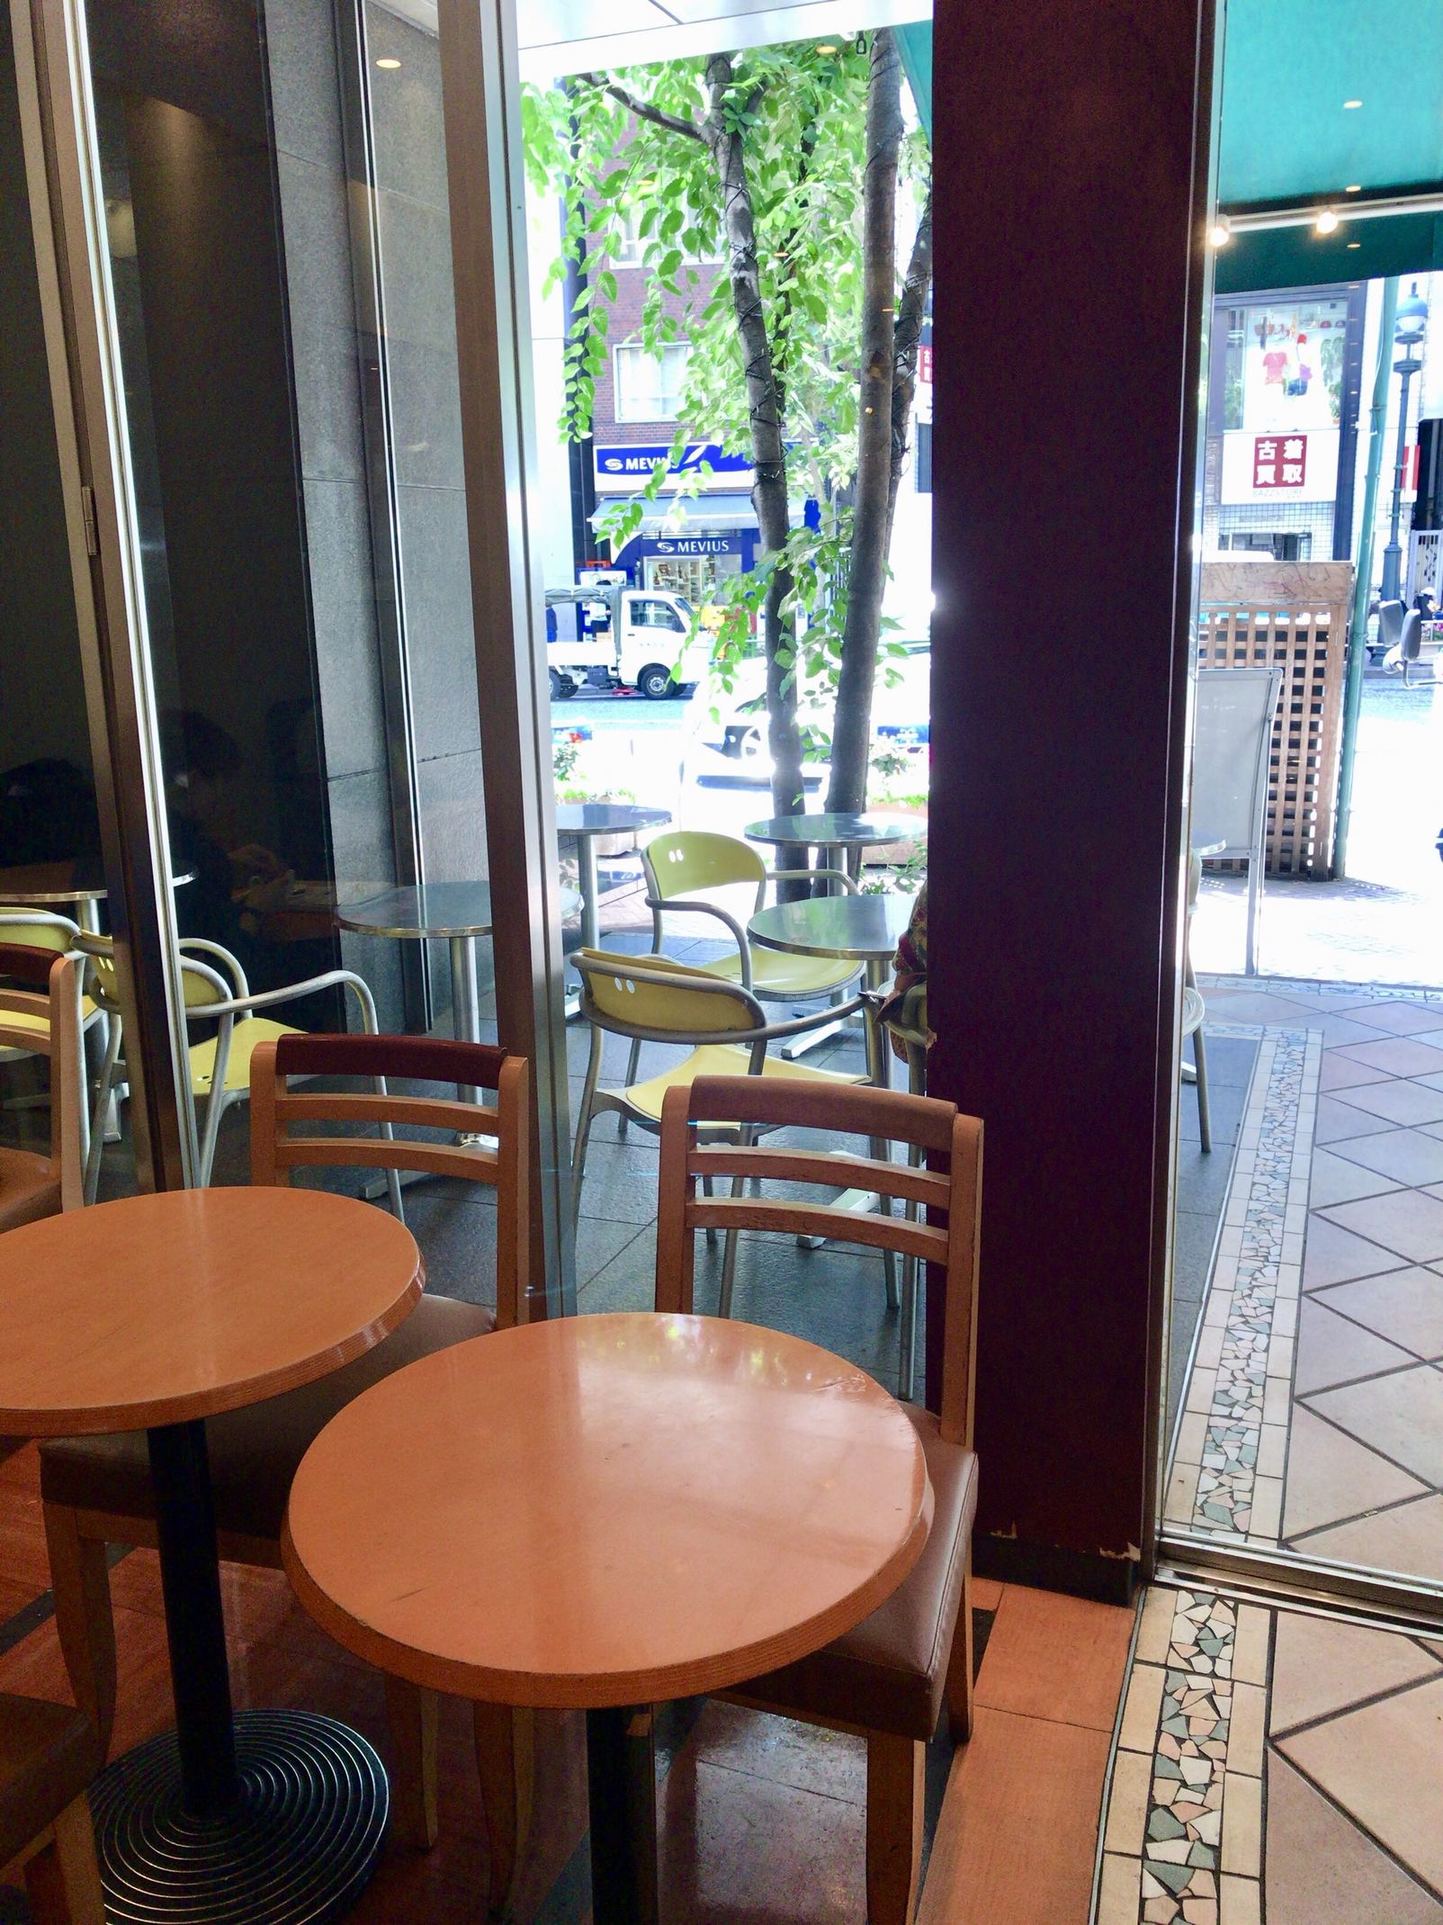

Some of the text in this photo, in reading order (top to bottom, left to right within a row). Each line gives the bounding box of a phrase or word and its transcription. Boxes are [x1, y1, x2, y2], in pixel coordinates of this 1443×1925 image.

[1257, 439, 1303, 460] 古着
[625, 456, 679, 470] MEV
[1256, 464, 1303, 484] 買取
[677, 540, 729, 553] MEVIUS
